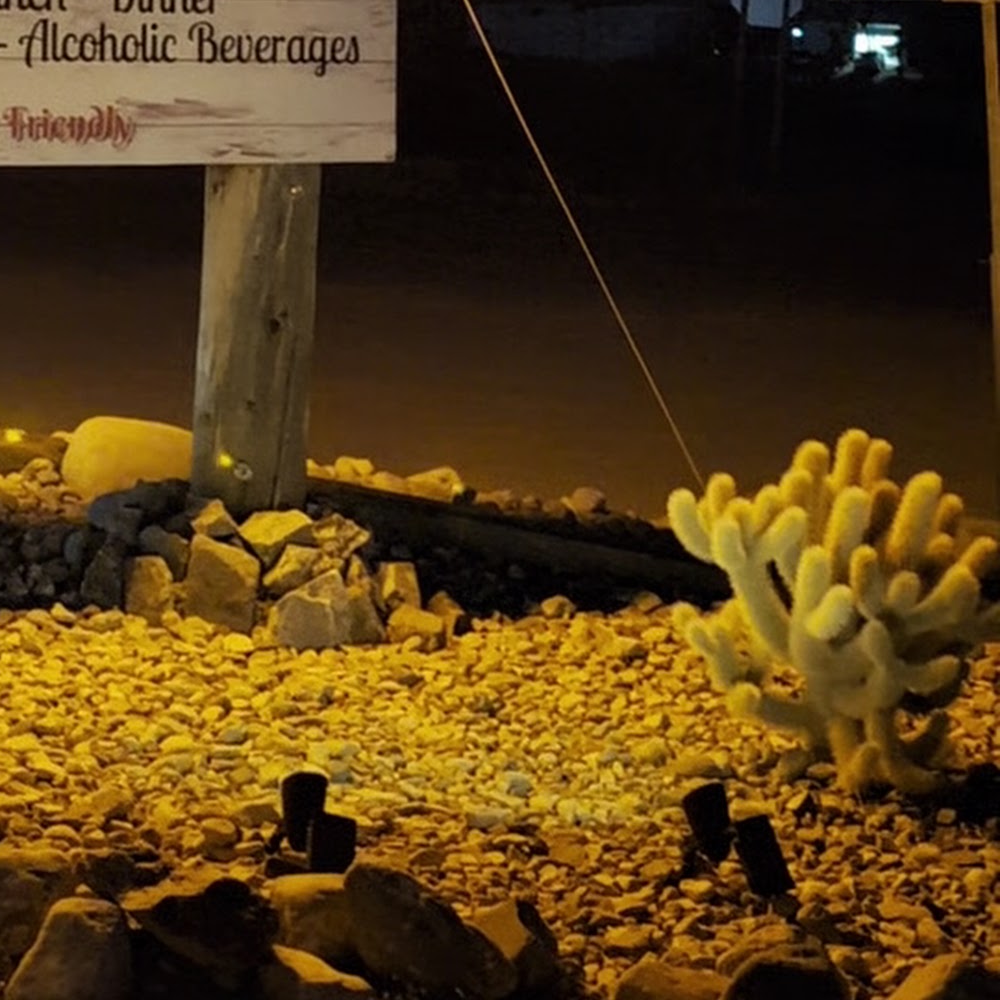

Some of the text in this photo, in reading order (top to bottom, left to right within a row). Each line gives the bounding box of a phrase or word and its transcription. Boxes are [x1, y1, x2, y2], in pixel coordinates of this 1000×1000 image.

[18, 18, 177, 68] Alcoholic
[189, 21, 360, 77] Beverages
[6, 105, 137, 146] Friendly
